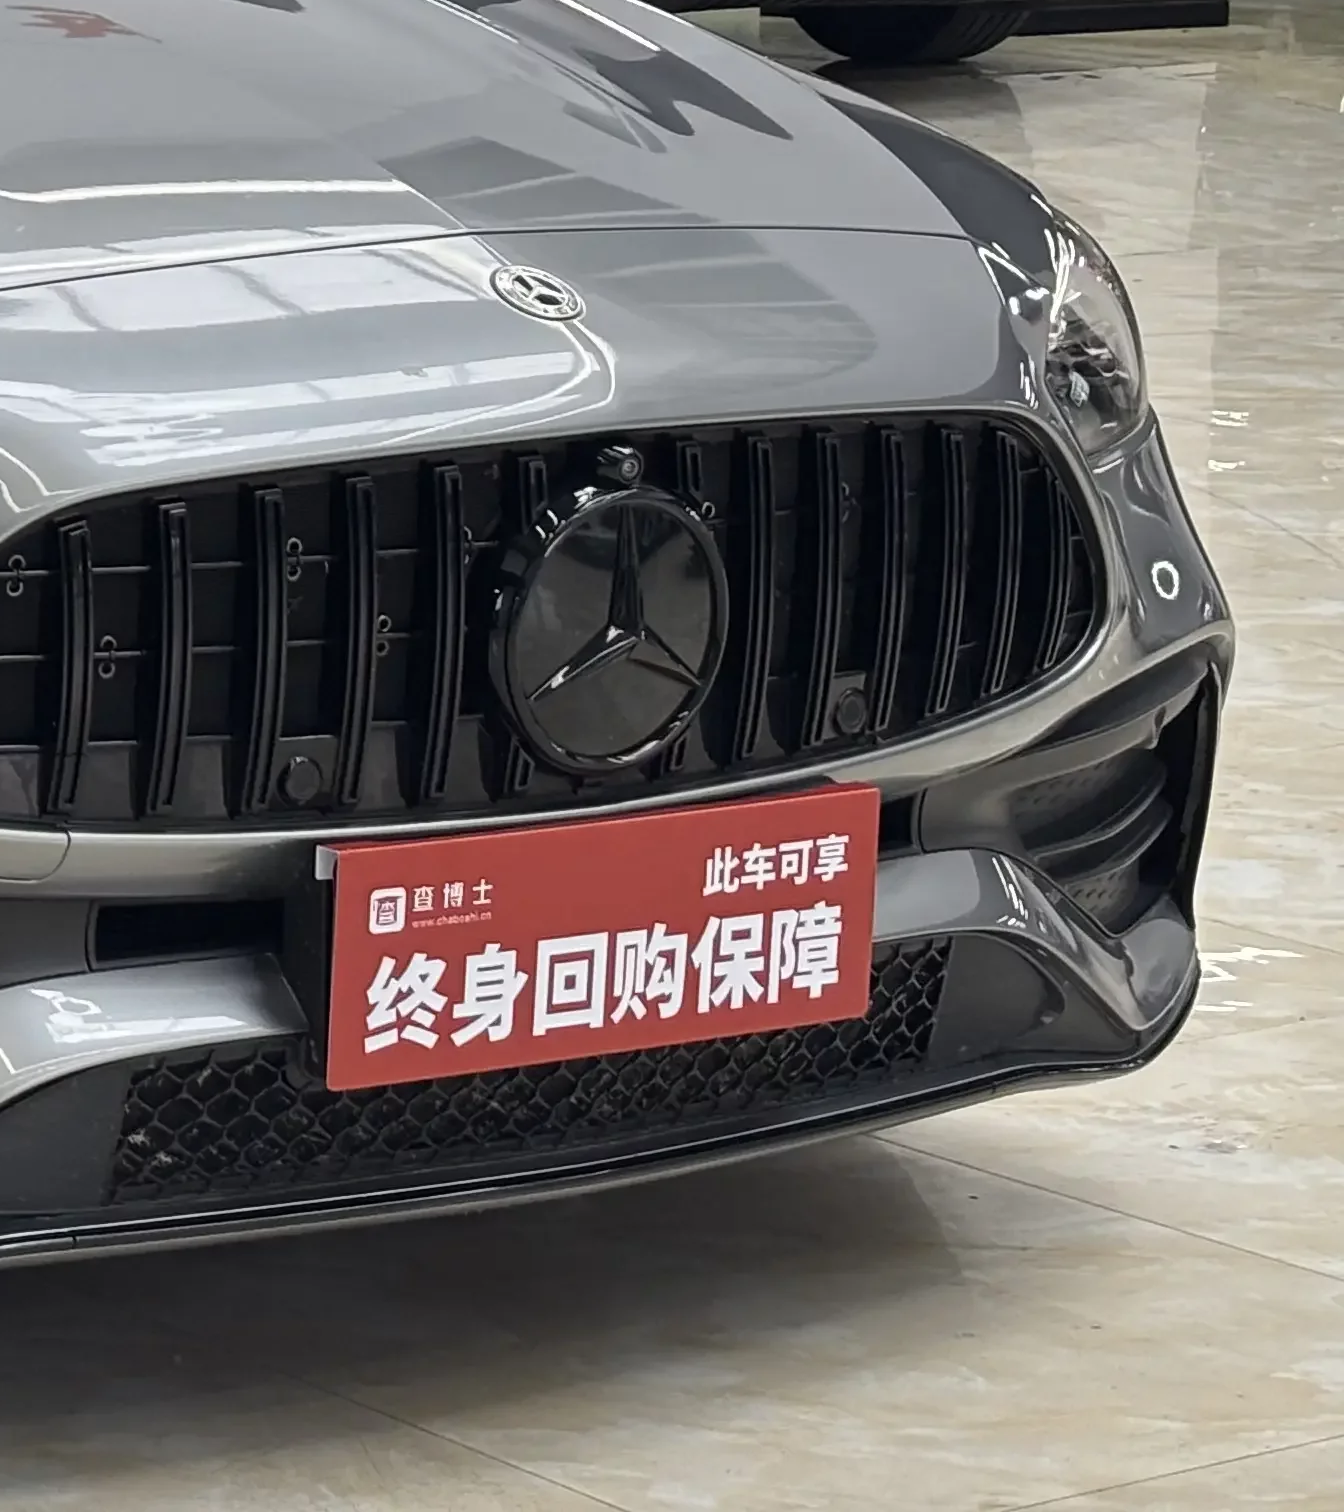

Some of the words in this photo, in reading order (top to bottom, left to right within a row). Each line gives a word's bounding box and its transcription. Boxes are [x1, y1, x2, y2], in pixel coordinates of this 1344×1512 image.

[412, 878, 494, 912] 查博士
[702, 834, 850, 897] 此车可享
[364, 900, 844, 1055] 终身回购保障
